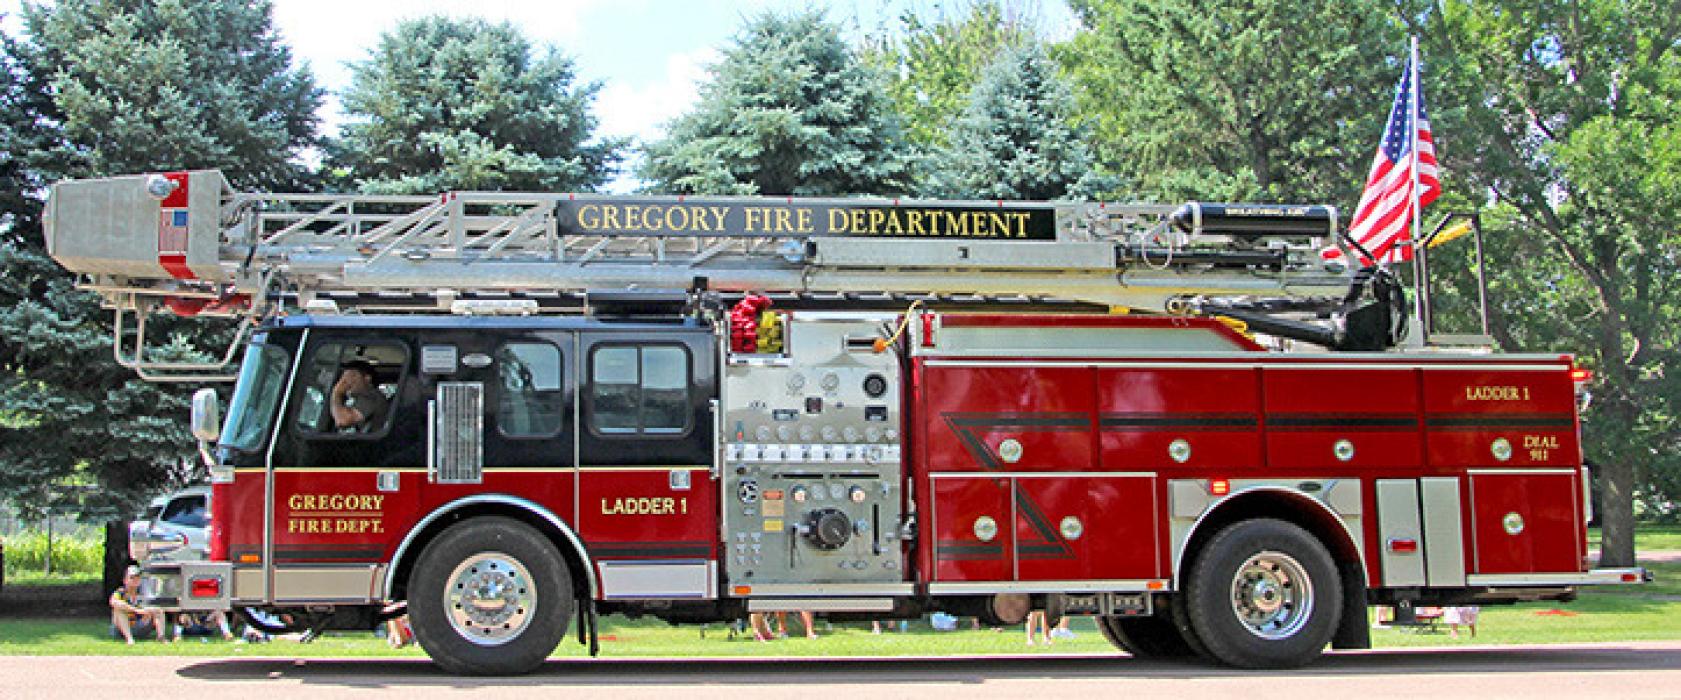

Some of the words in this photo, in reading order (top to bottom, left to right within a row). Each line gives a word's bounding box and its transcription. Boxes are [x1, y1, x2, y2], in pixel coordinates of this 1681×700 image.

[577, 204, 729, 231] GREGORY
[744, 206, 815, 234] FIRE
[828, 208, 1031, 238] DEPARTMENT
[1466, 386, 1519, 400] LADDER
[1523, 435, 1559, 449] DIAL
[288, 493, 384, 510] GREGORY
[601, 497, 675, 514] LADDER
[681, 497, 687, 514] 1
[288, 519, 331, 533] FIRE
[335, 519, 384, 533] DEPT.
